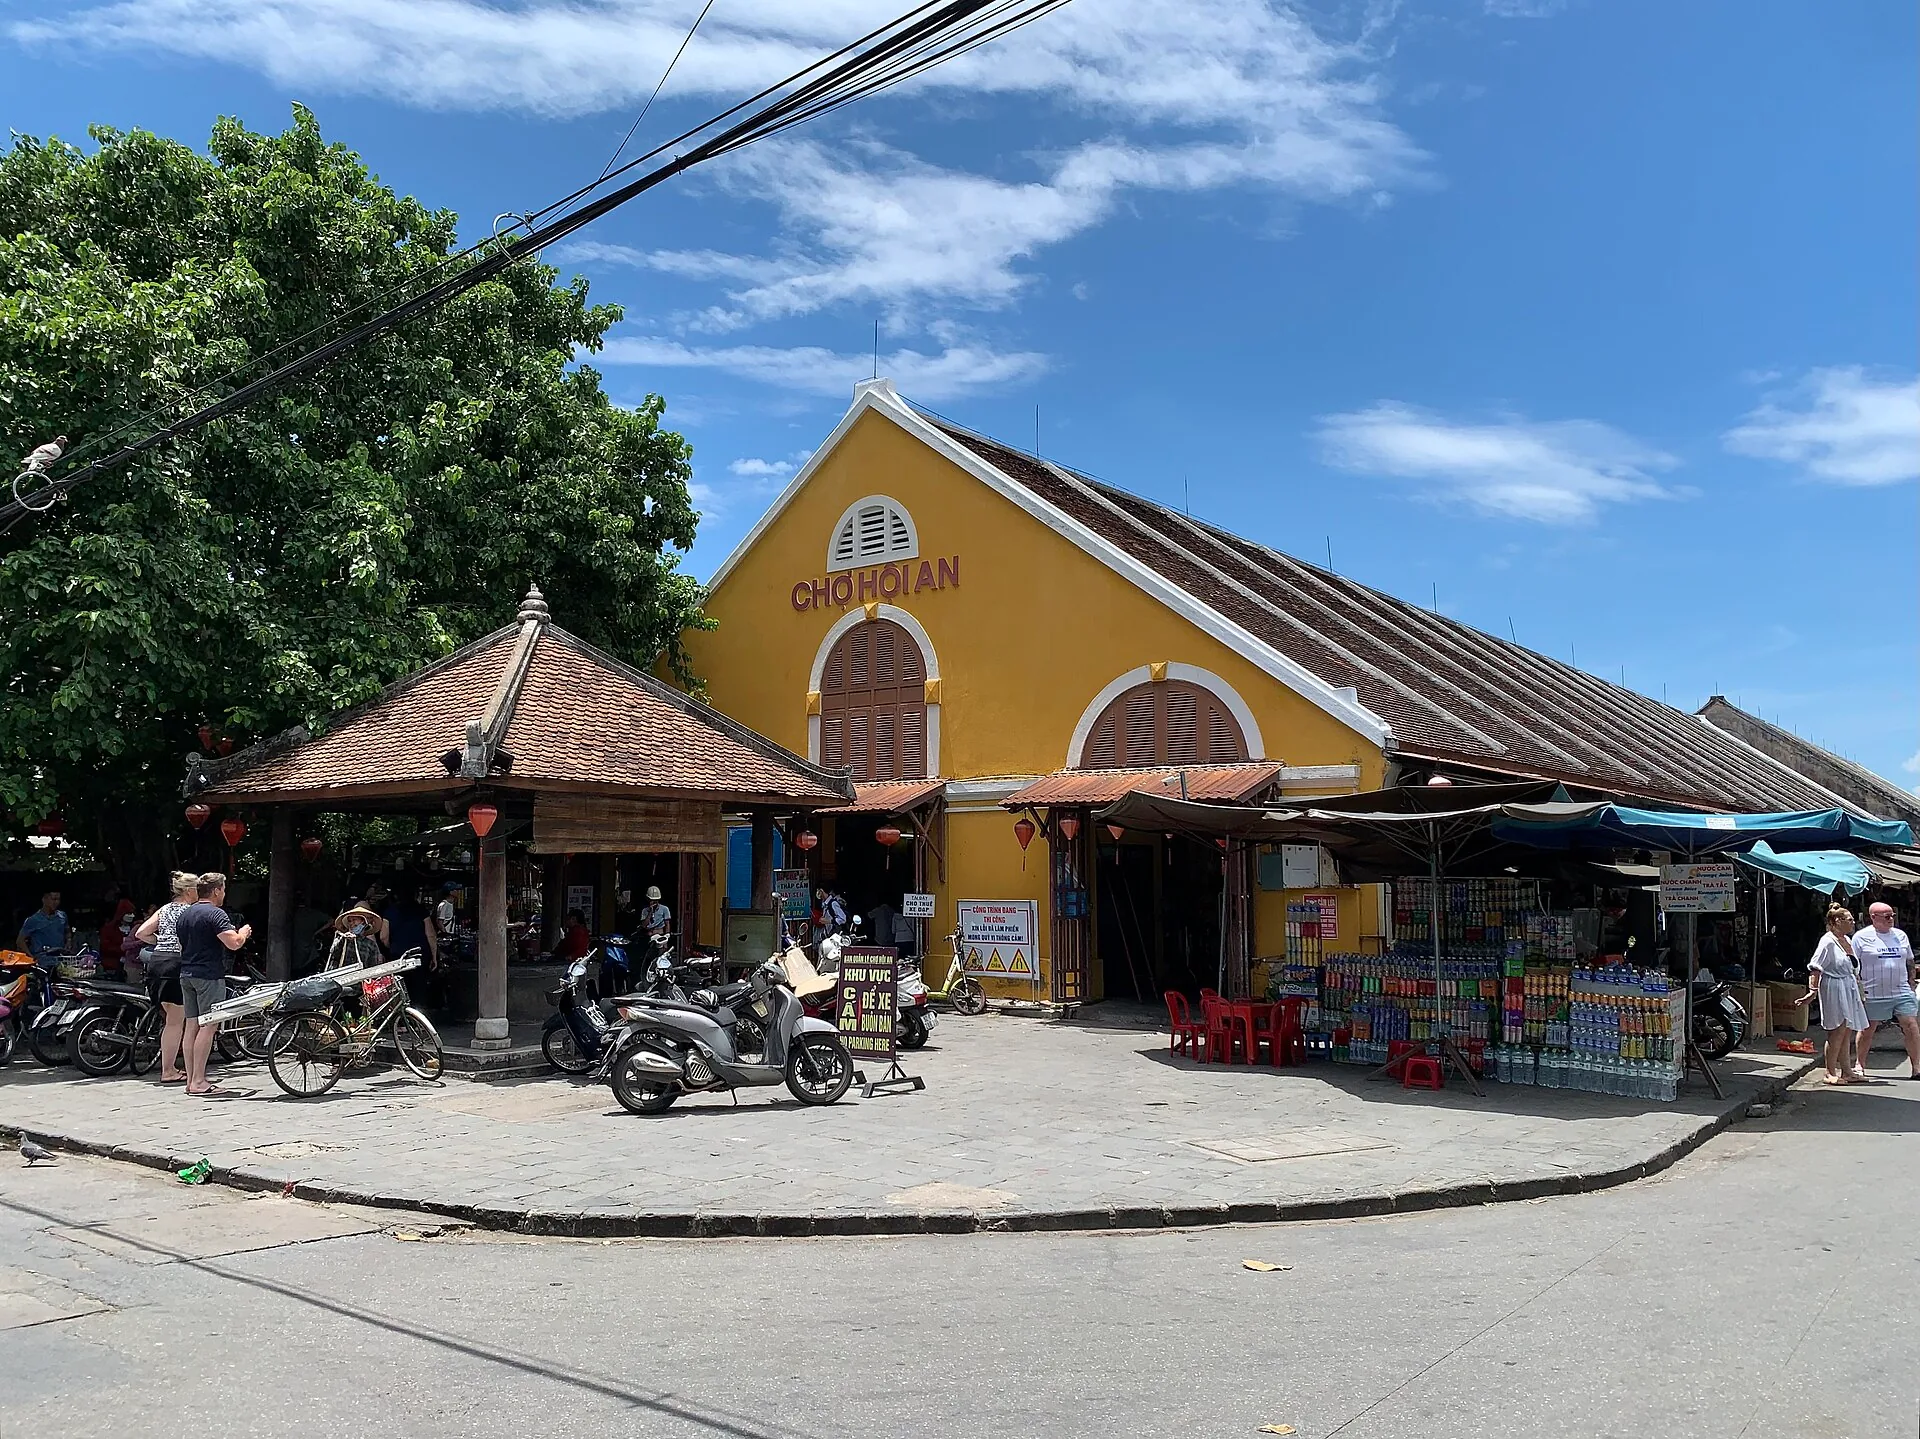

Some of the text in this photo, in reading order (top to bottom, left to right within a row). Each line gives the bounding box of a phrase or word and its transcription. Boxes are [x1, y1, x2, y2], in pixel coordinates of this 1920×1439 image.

[791, 555, 960, 611] CHỢ HỘI AN
[972, 905, 987, 913] CÔNG
[992, 915, 1006, 923] CÔNG
[843, 968, 891, 985] KHU VỰC
[862, 984, 892, 1010] ĐỂ XE
[861, 1010, 892, 1033] BUÔN BÁN
[848, 1036, 874, 1051] PARKING
[874, 1037, 890, 1052] HERE
